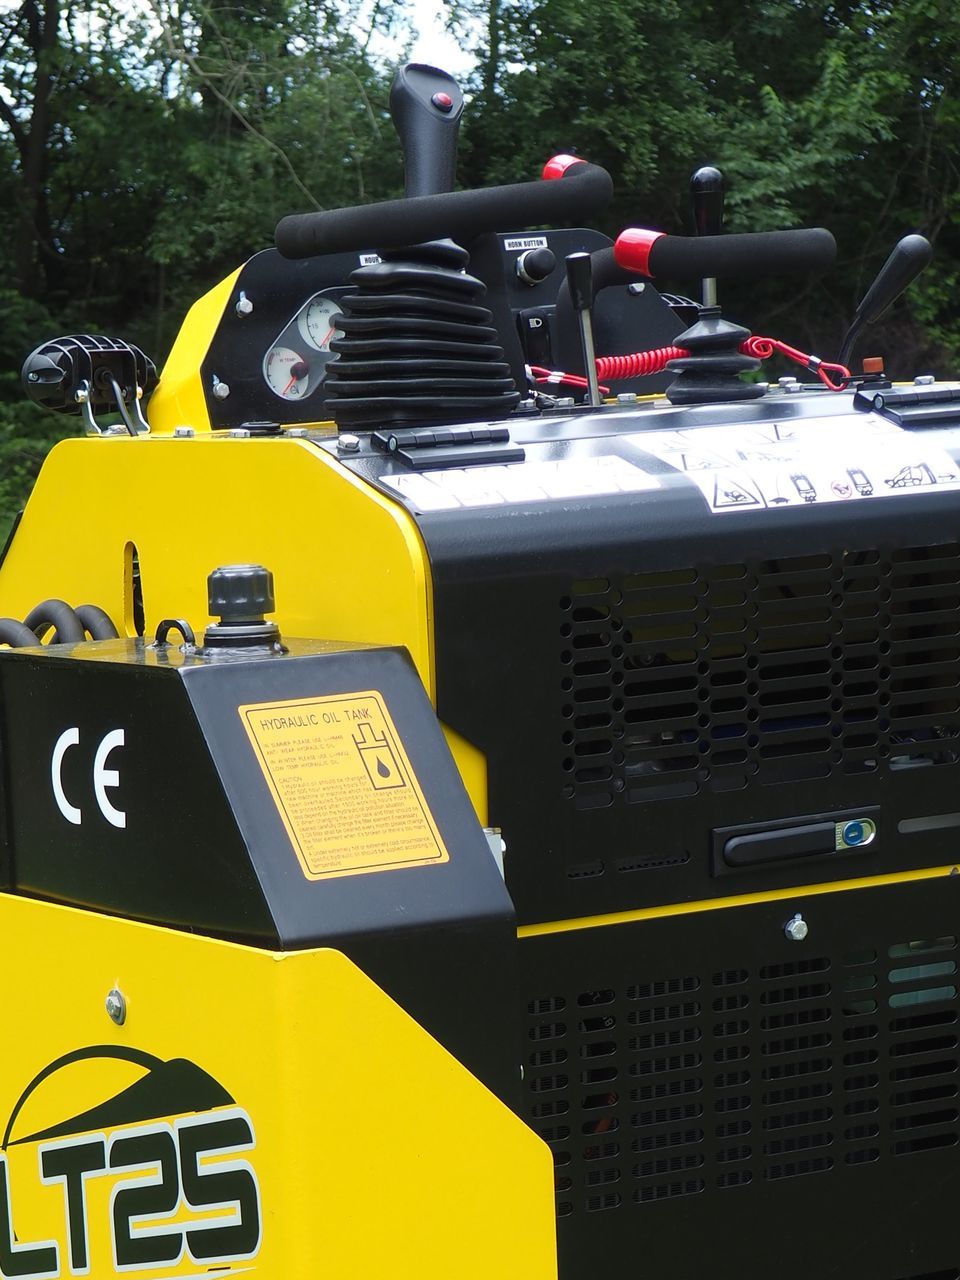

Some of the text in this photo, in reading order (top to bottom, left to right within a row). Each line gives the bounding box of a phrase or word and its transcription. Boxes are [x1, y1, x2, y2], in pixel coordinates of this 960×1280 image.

[508, 239, 544, 249] HORN BUTTON
[364, 256, 379, 264] HOUR
[261, 708, 374, 731] HYDRAULIC OIL TANK
[51, 727, 126, 828] CE
